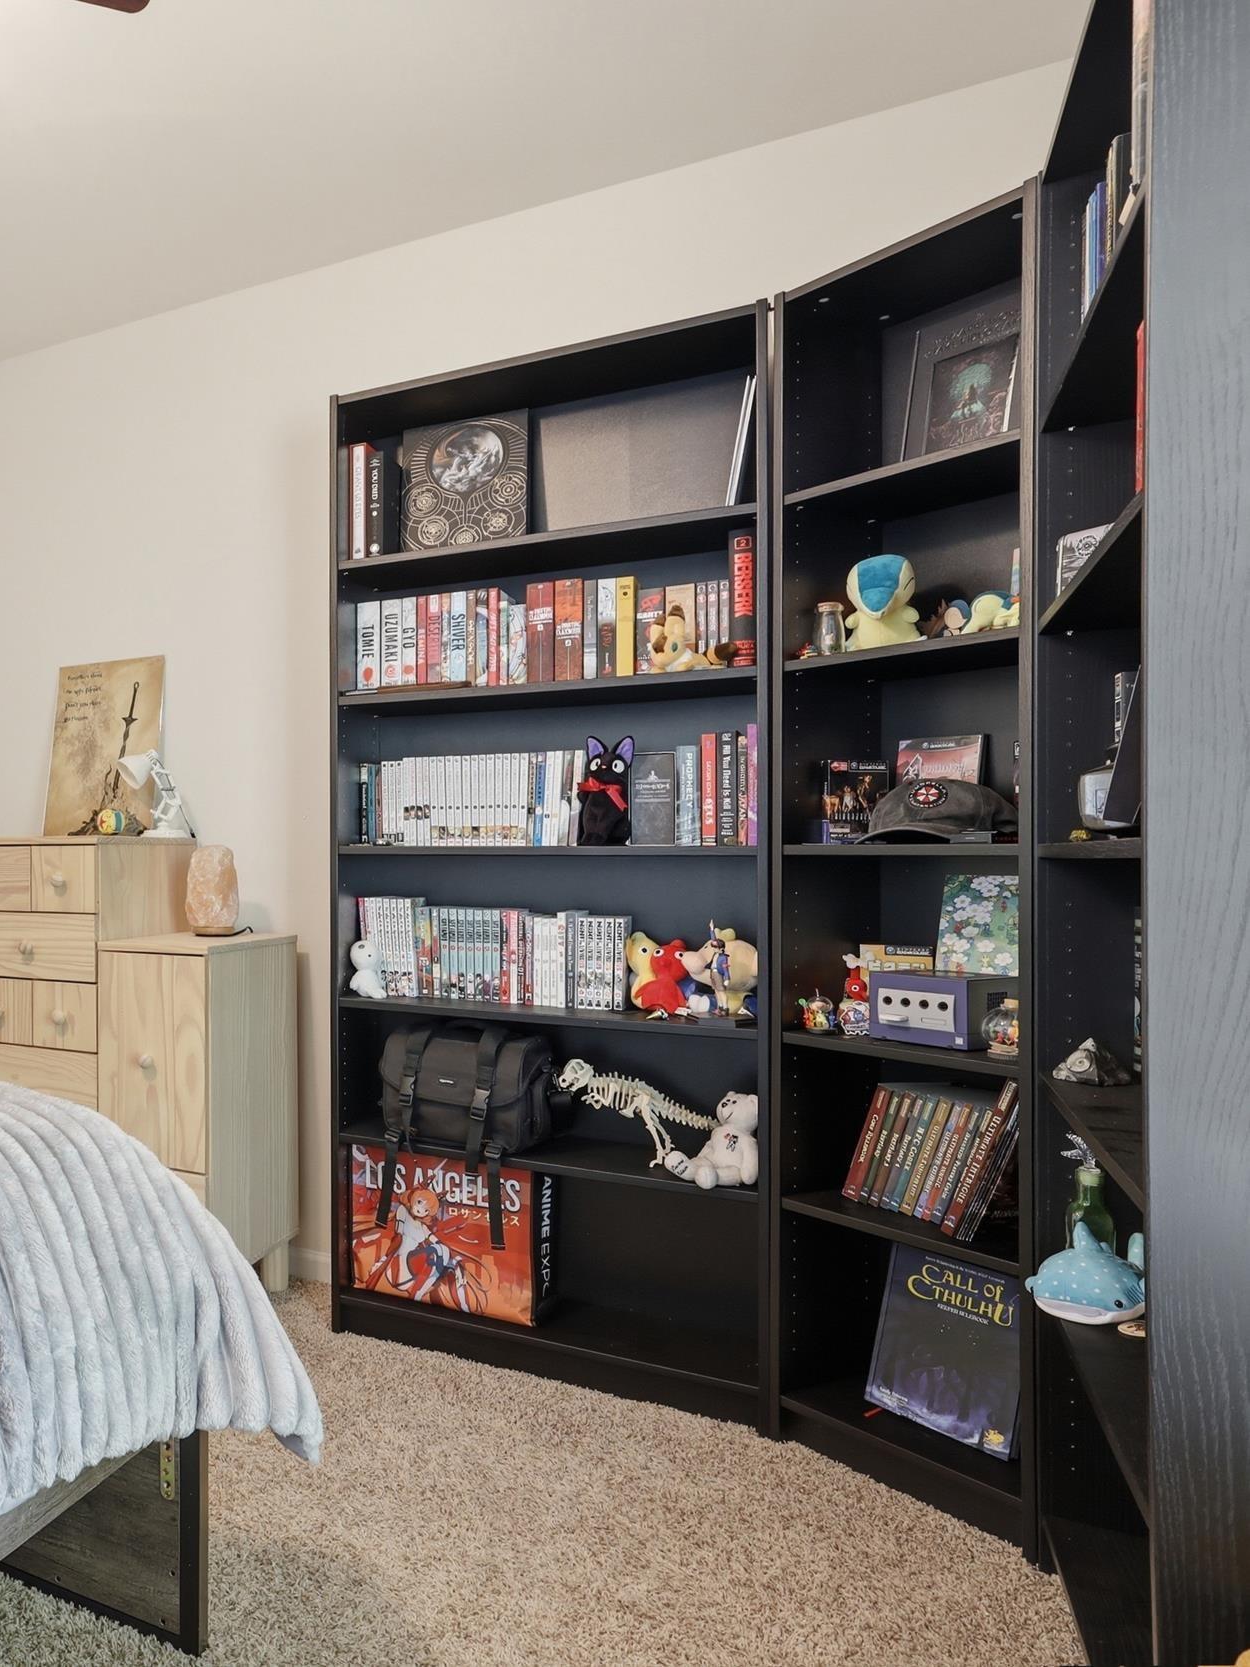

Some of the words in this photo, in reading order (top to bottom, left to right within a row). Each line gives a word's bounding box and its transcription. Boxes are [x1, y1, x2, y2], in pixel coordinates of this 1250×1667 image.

[734, 552, 753, 618] BERSERK
[361, 624, 374, 659] TOMIE
[385, 613, 398, 663] UZUMAKI
[403, 627, 415, 649] GYO
[451, 613, 465, 652] SHIVER
[686, 753, 694, 809] PROPHECY
[723, 756, 731, 769] You
[723, 770, 731, 788] Need
[912, 1126, 924, 1146] NPC
[974, 1114, 1001, 1161] ULTIMATE
[903, 1146, 917, 1171] CODEX
[414, 1167, 521, 1212] ANGELS
[955, 1161, 980, 1204] INTRIGUE
[541, 1176, 552, 1239] ANIME
[922, 1264, 979, 1294] CALL
[907, 1275, 1014, 1327] CTHULHU
